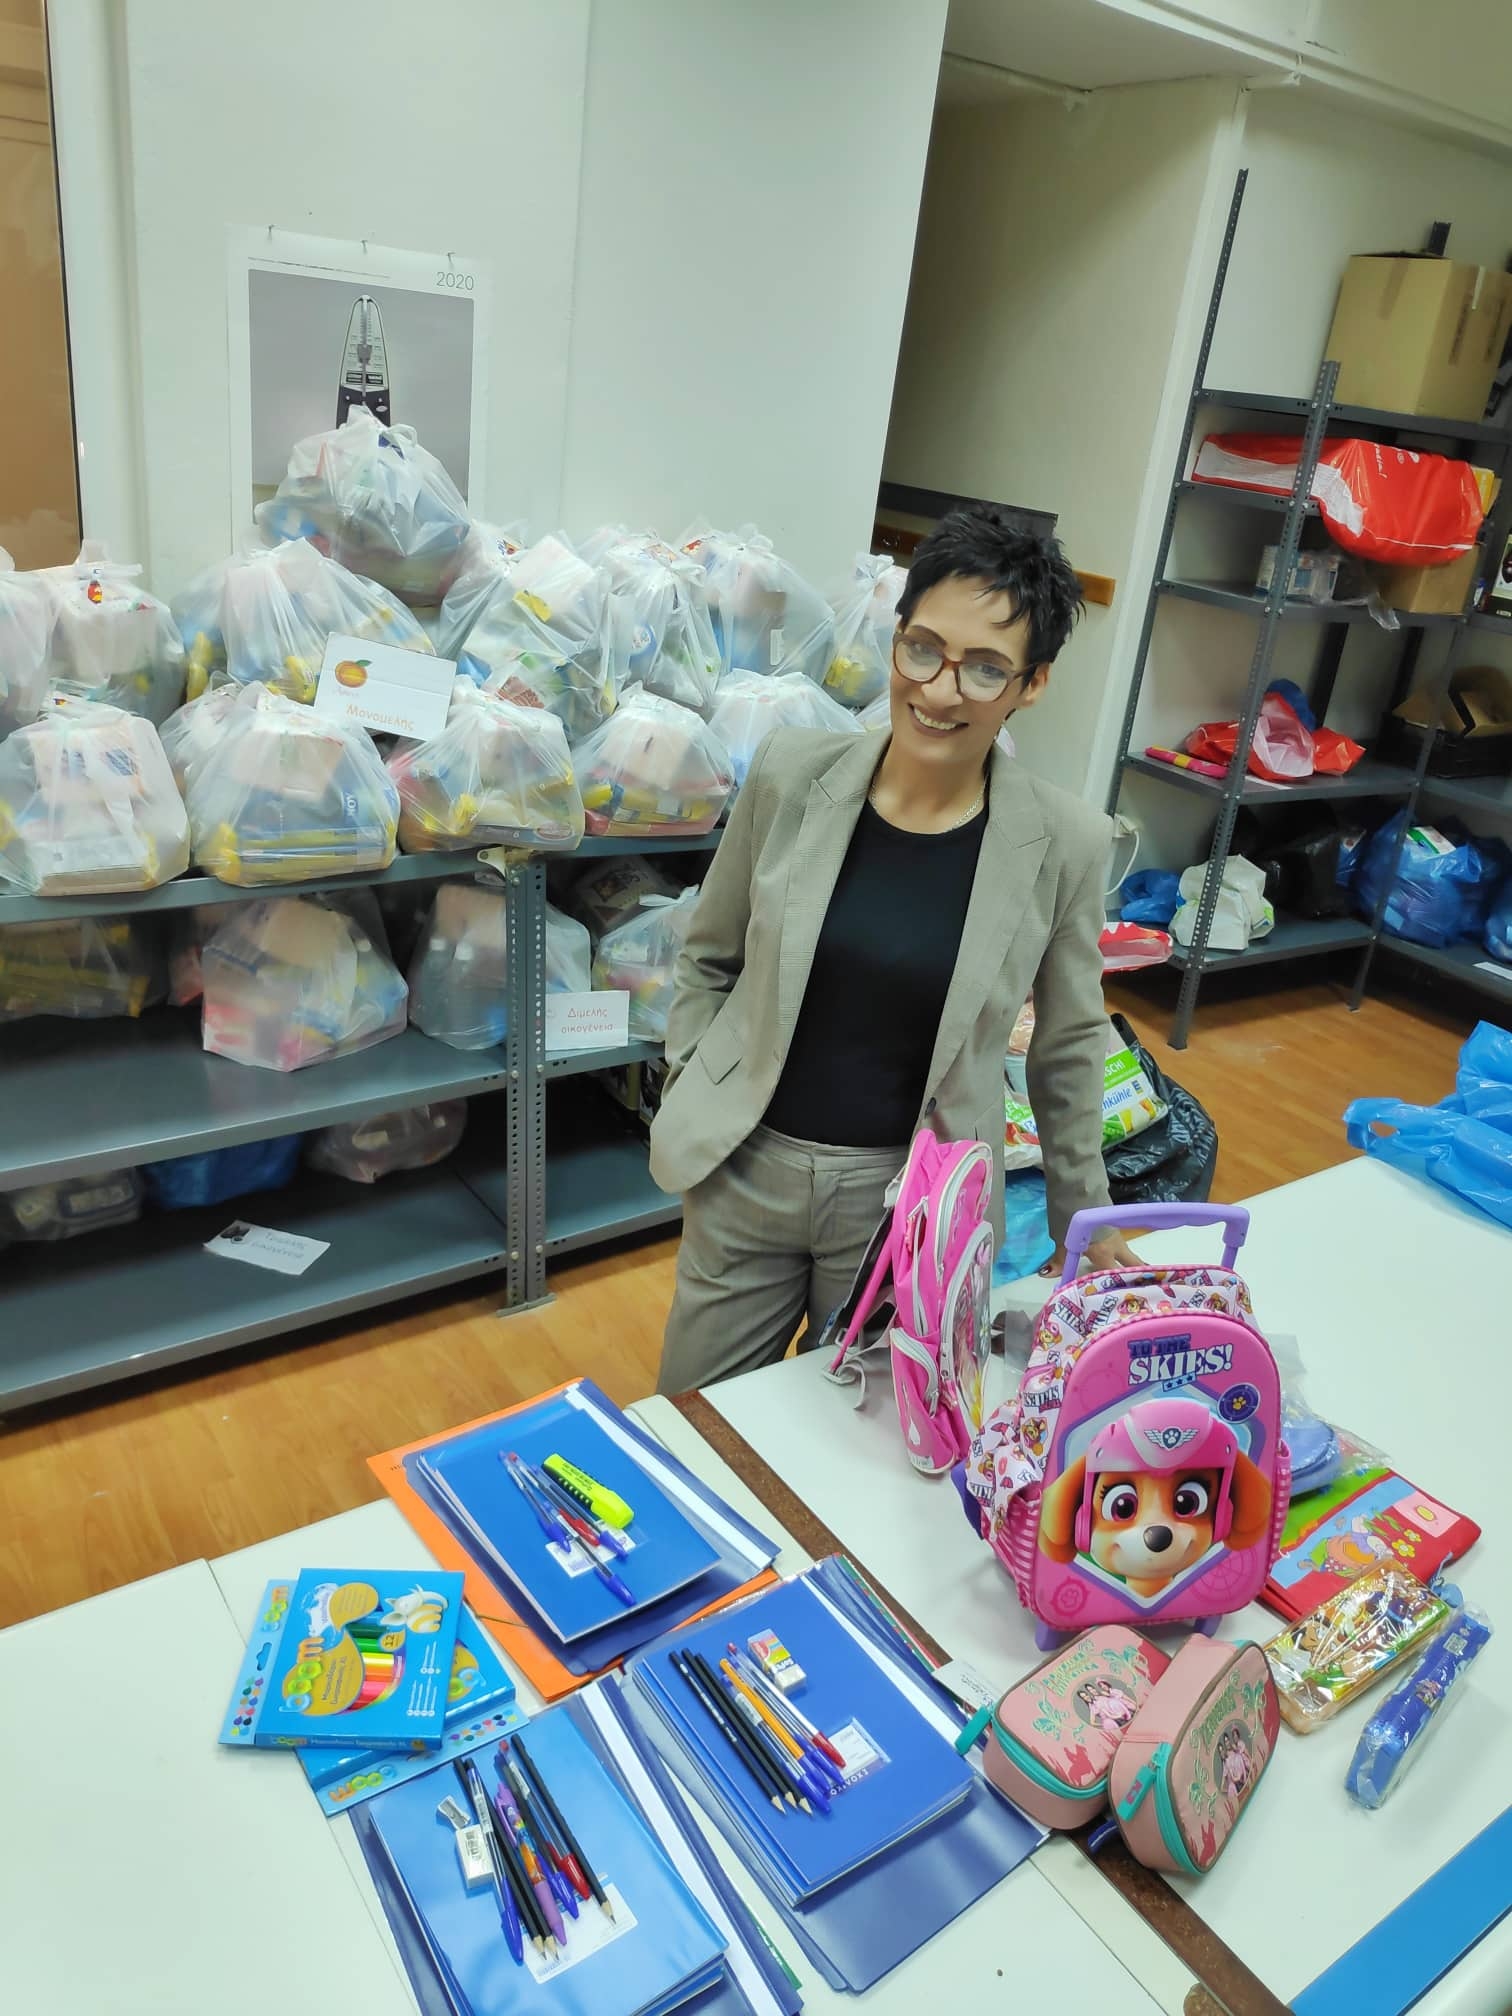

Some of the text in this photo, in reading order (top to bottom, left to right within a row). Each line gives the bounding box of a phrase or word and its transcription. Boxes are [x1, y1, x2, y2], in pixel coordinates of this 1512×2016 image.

[436, 271, 474, 291] 2020
[1128, 1333, 1192, 1359] TO THE
[1128, 1343, 1234, 1386] SKIES!
[278, 1637, 325, 1713] boom
[328, 1763, 398, 1803] boom
